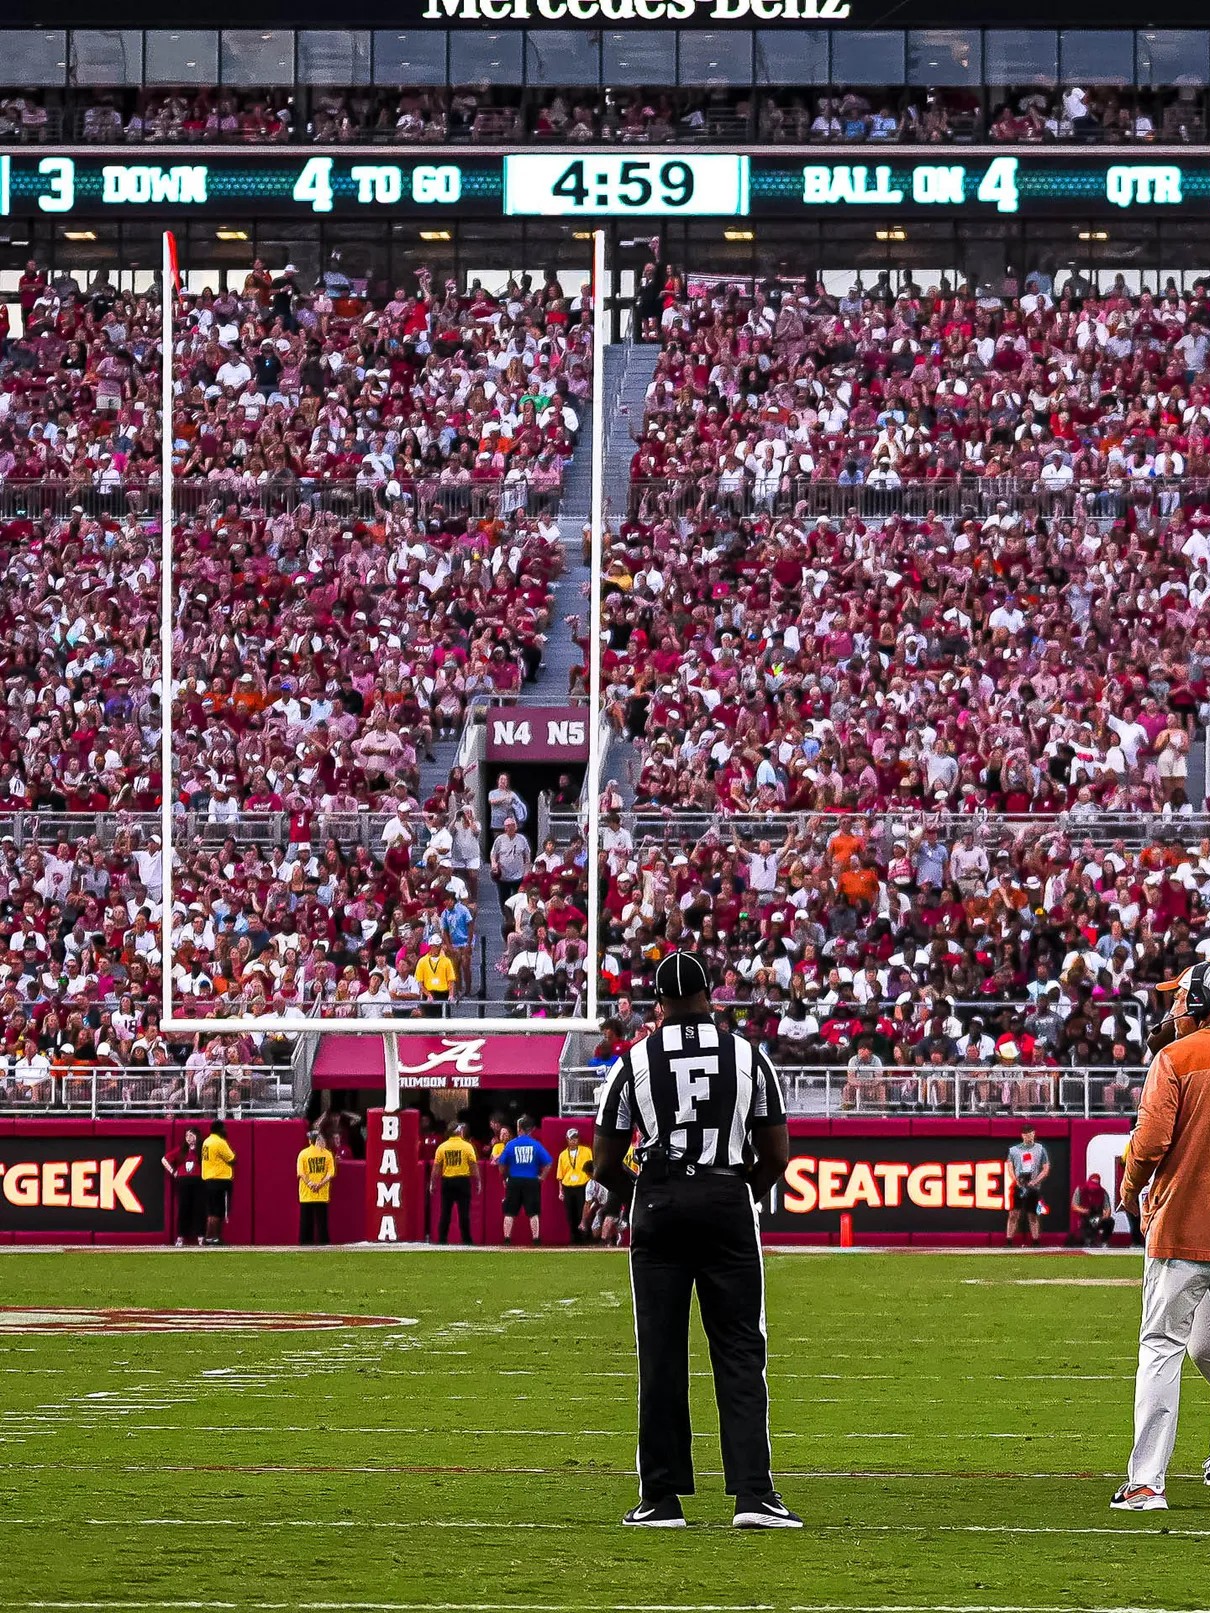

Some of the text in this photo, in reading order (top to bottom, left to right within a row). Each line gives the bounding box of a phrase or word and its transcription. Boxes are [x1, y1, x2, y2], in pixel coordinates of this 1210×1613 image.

[38, 157, 207, 212] 3 DOWN
[293, 157, 462, 212] 4 TO GO
[553, 160, 694, 206] 4:59
[803, 157, 1018, 212] BALL ON 4
[1106, 166, 1183, 208] QTR
[493, 720, 585, 746] N4 N5
[399, 1076, 480, 1088] RIMSON TIDE
[669, 1055, 720, 1125] F
[0, 1155, 144, 1214] GEEK
[376, 1115, 401, 1241] BAMA
